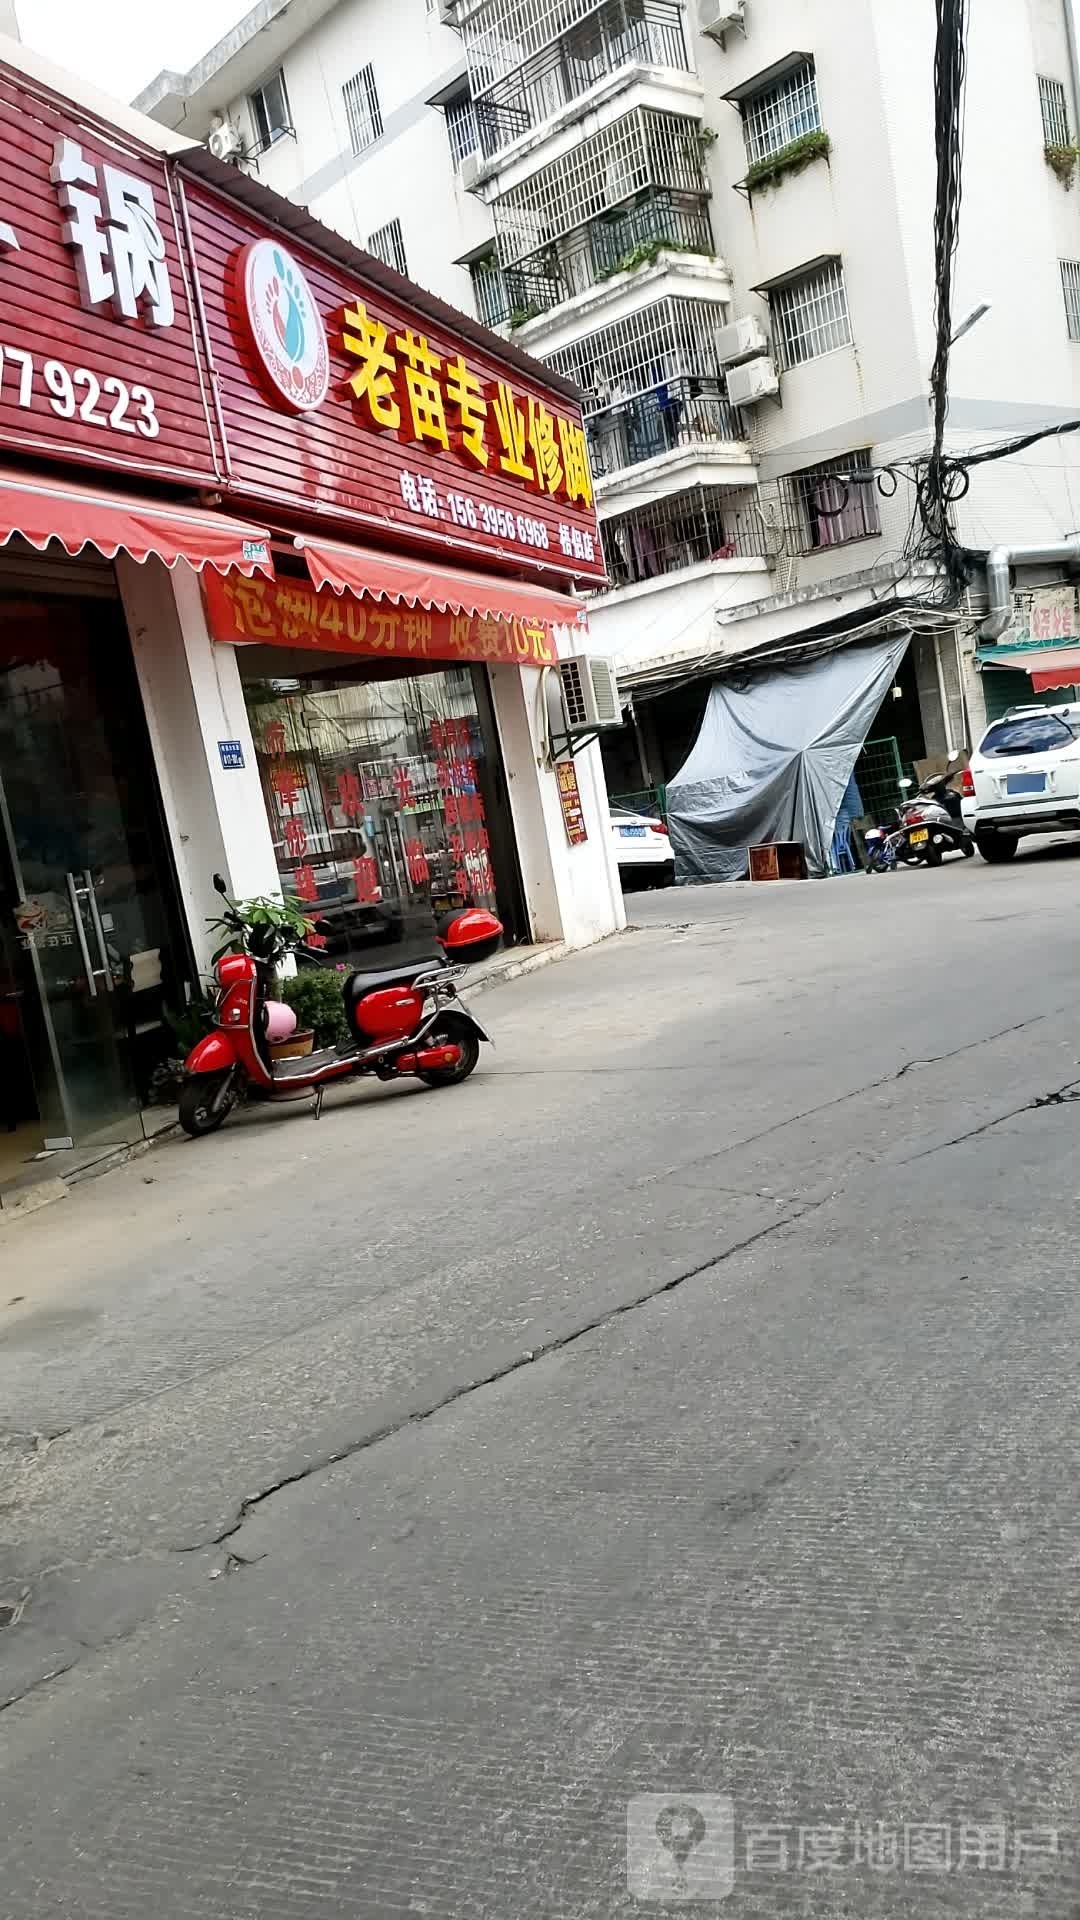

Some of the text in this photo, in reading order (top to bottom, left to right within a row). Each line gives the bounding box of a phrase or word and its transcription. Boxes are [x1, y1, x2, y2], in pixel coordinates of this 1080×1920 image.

[0, 137, 174, 328] 锅
[340, 299, 593, 509] 老苗专业修脚
